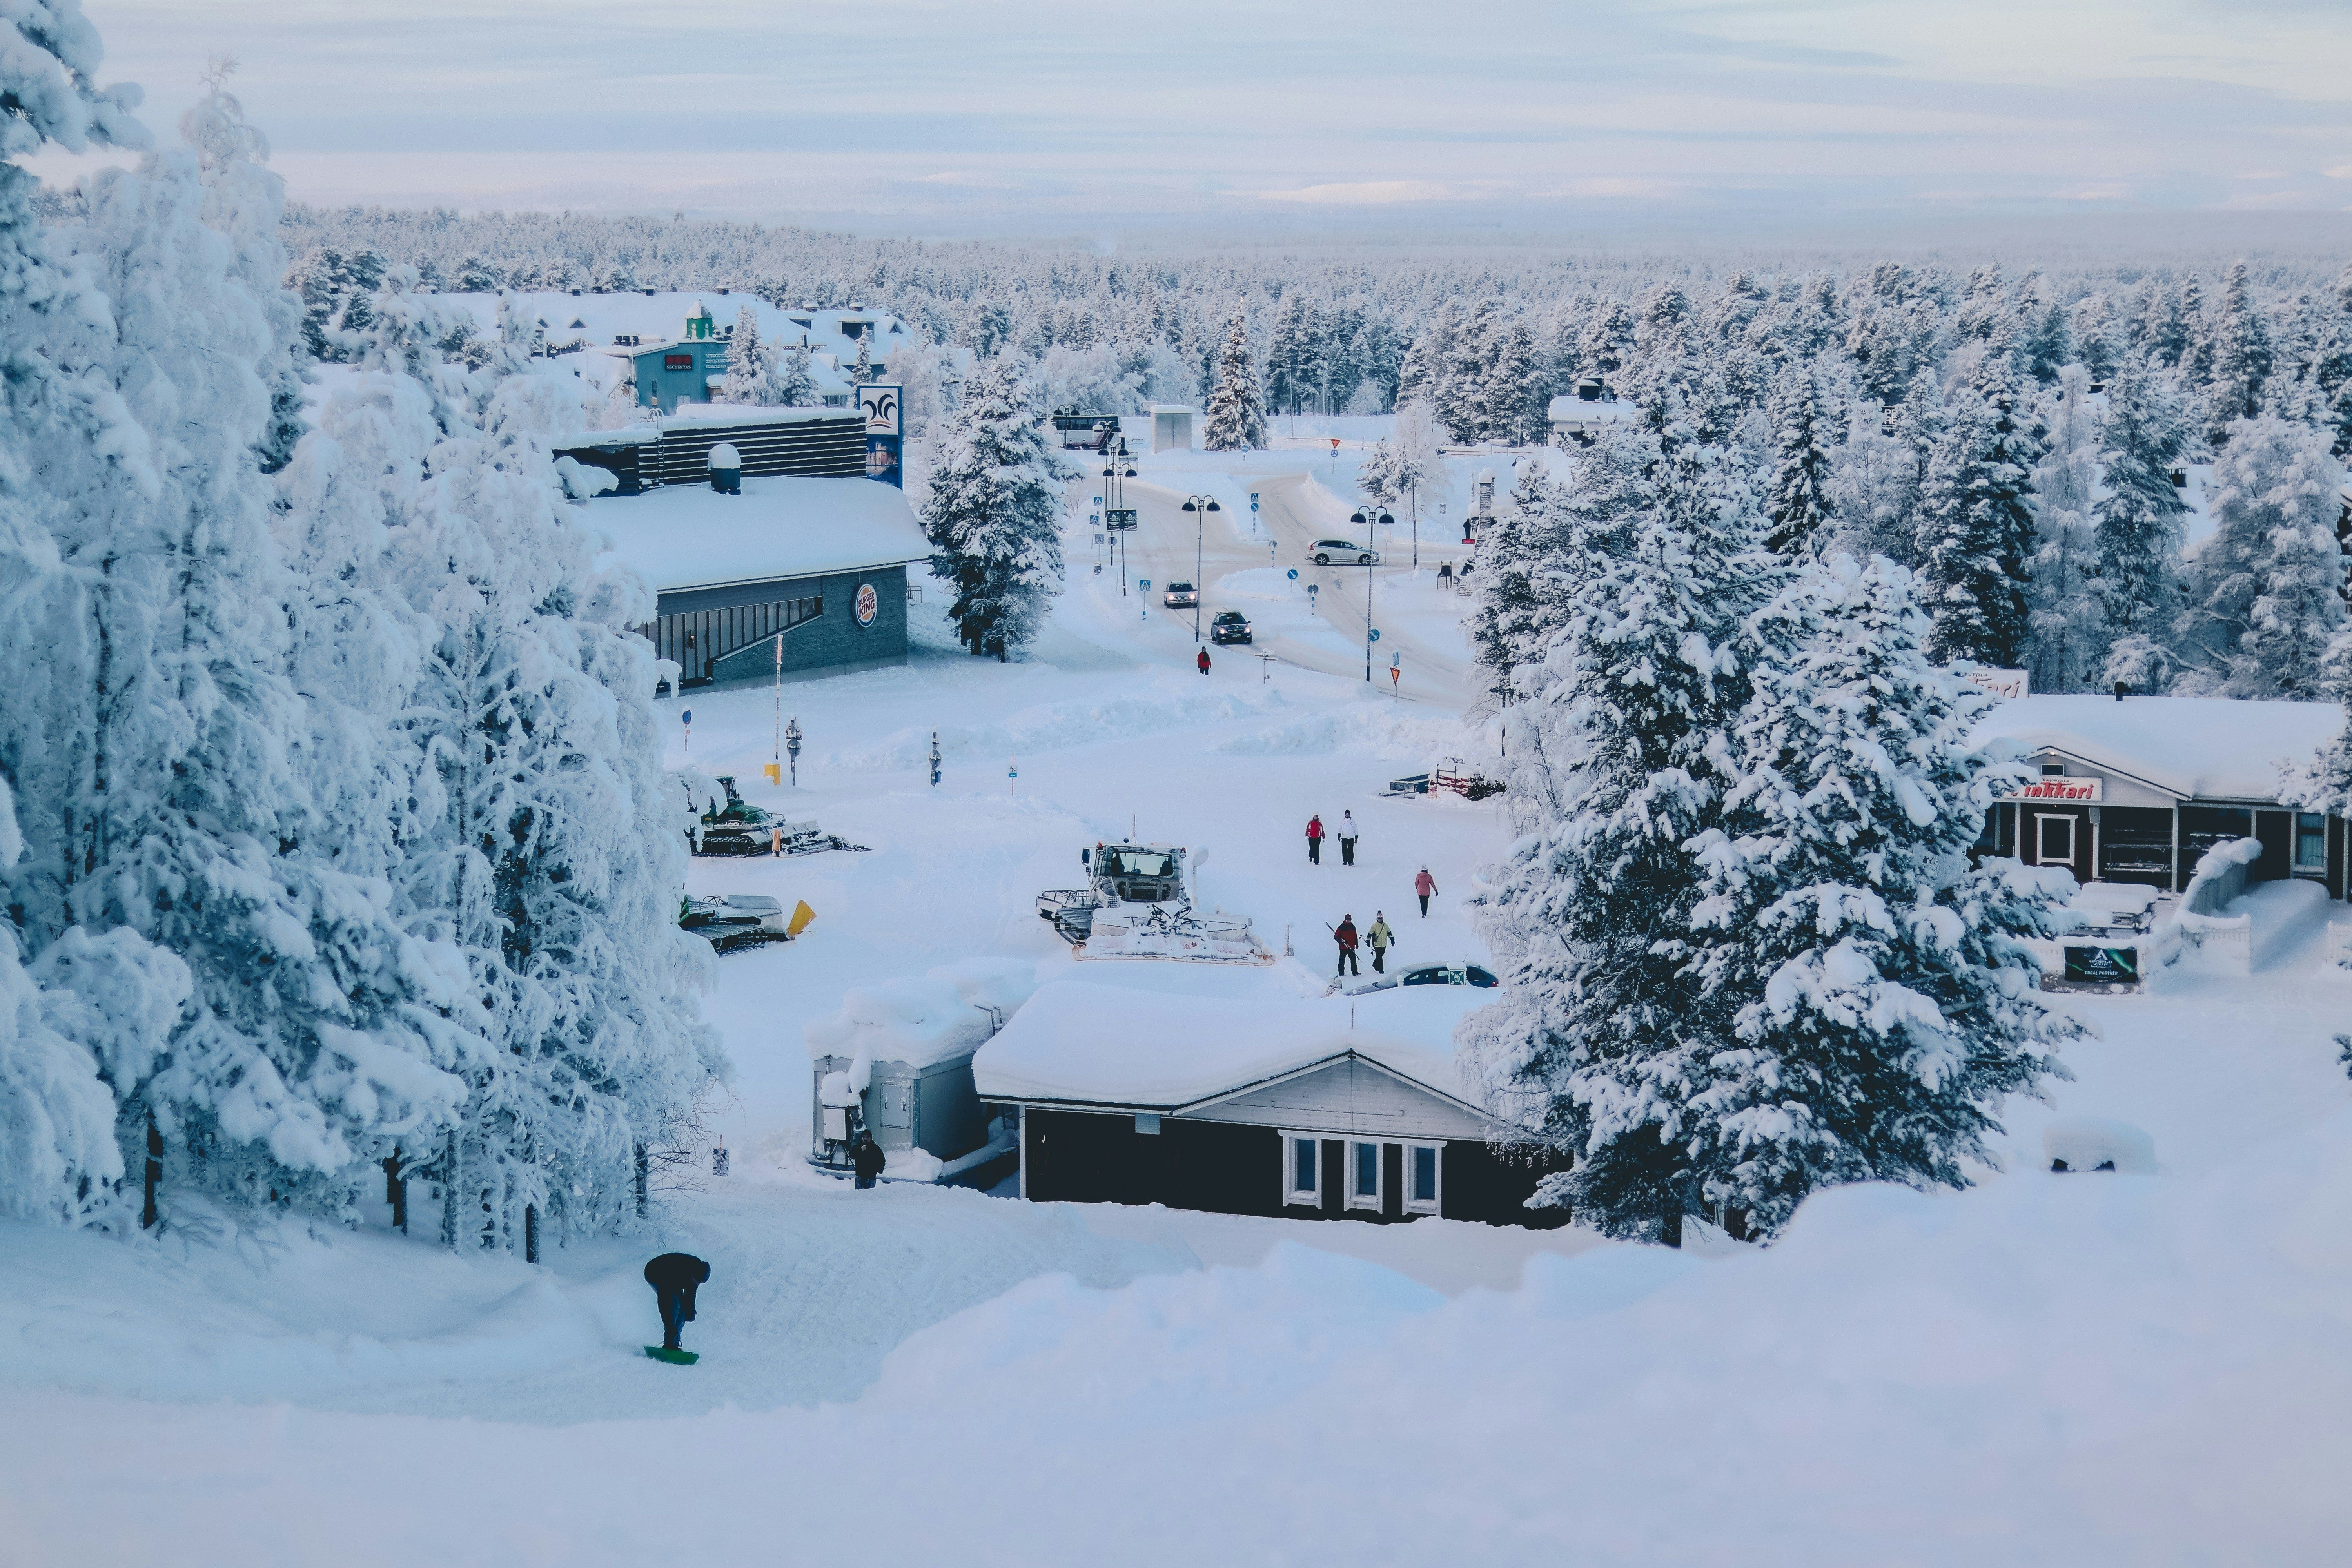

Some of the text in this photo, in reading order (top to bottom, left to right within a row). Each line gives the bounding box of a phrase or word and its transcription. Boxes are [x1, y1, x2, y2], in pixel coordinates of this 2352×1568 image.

[858, 592, 875, 608] BURGER
[859, 599, 875, 618] KING
[2011, 782, 2094, 799] inkkari
